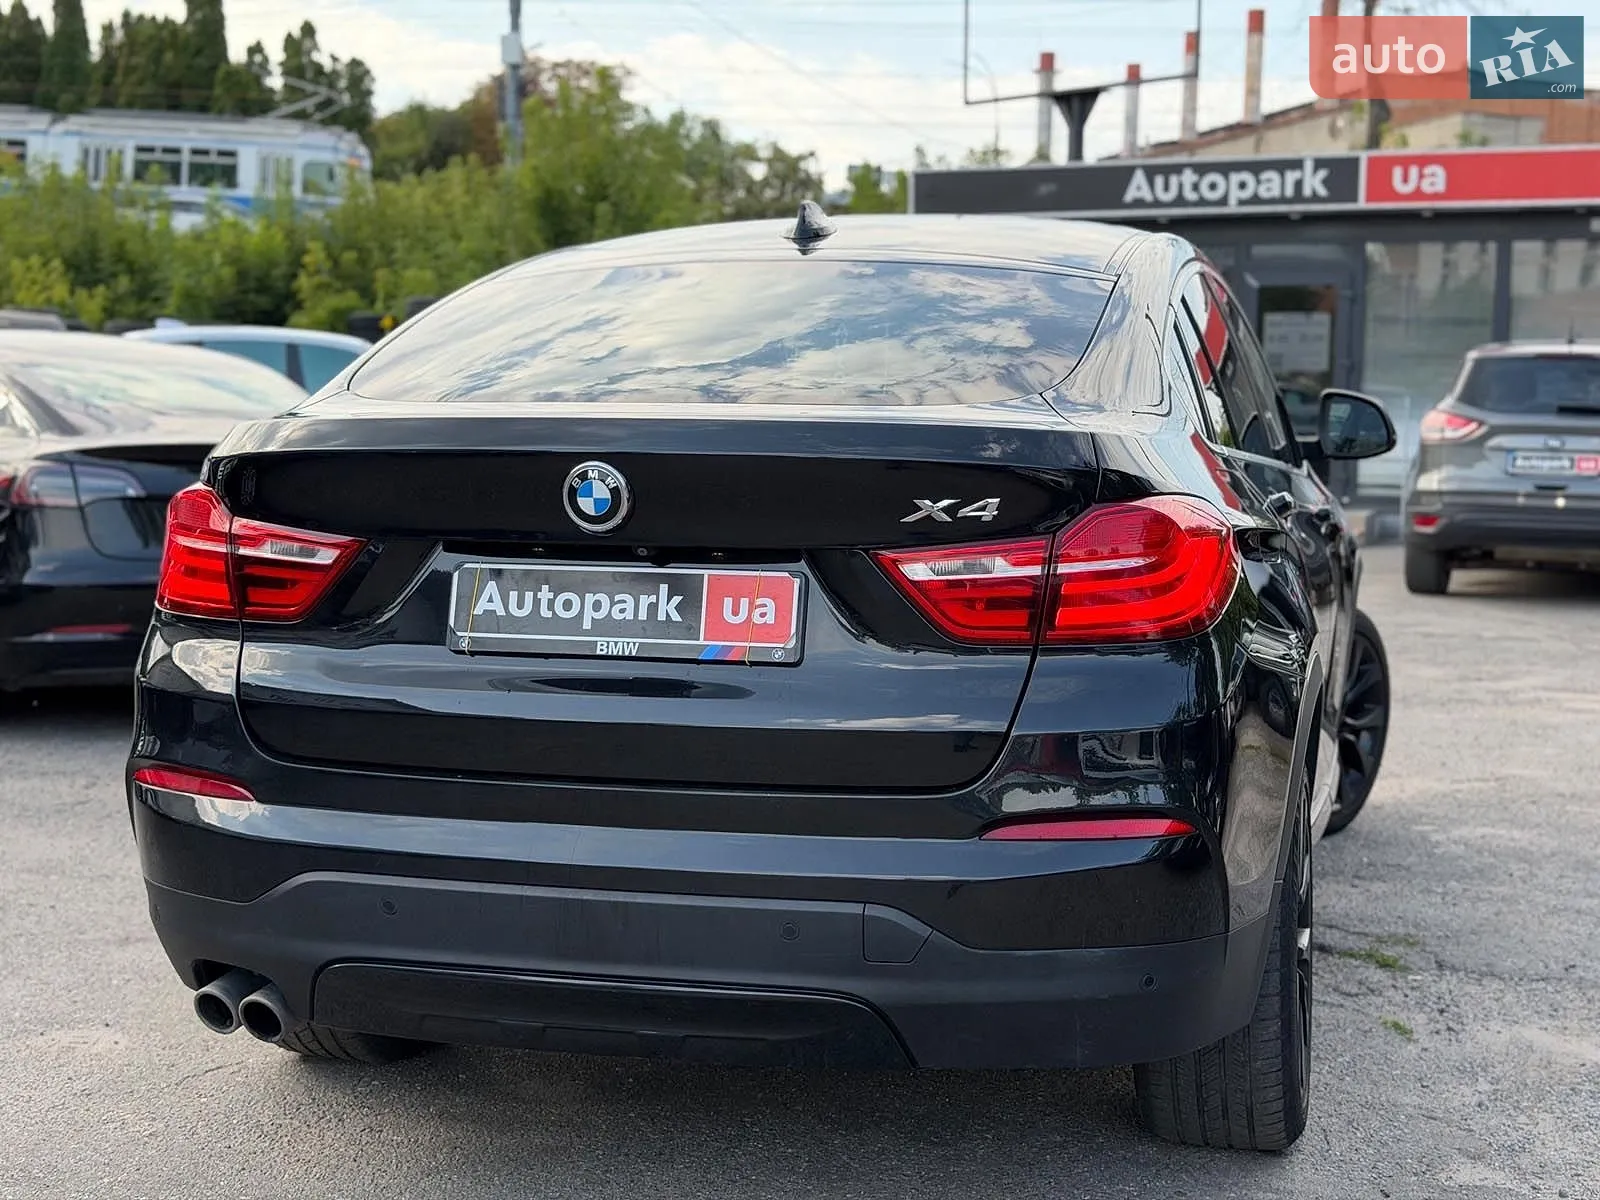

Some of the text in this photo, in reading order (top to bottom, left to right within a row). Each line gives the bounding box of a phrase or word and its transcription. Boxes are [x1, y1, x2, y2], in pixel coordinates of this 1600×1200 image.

[1122, 157, 1447, 207] Autopark ua
[571, 469, 617, 489] BMW
[900, 498, 1001, 522] X4
[473, 580, 776, 630] Autopark ua
[596, 641, 639, 656] BMW
